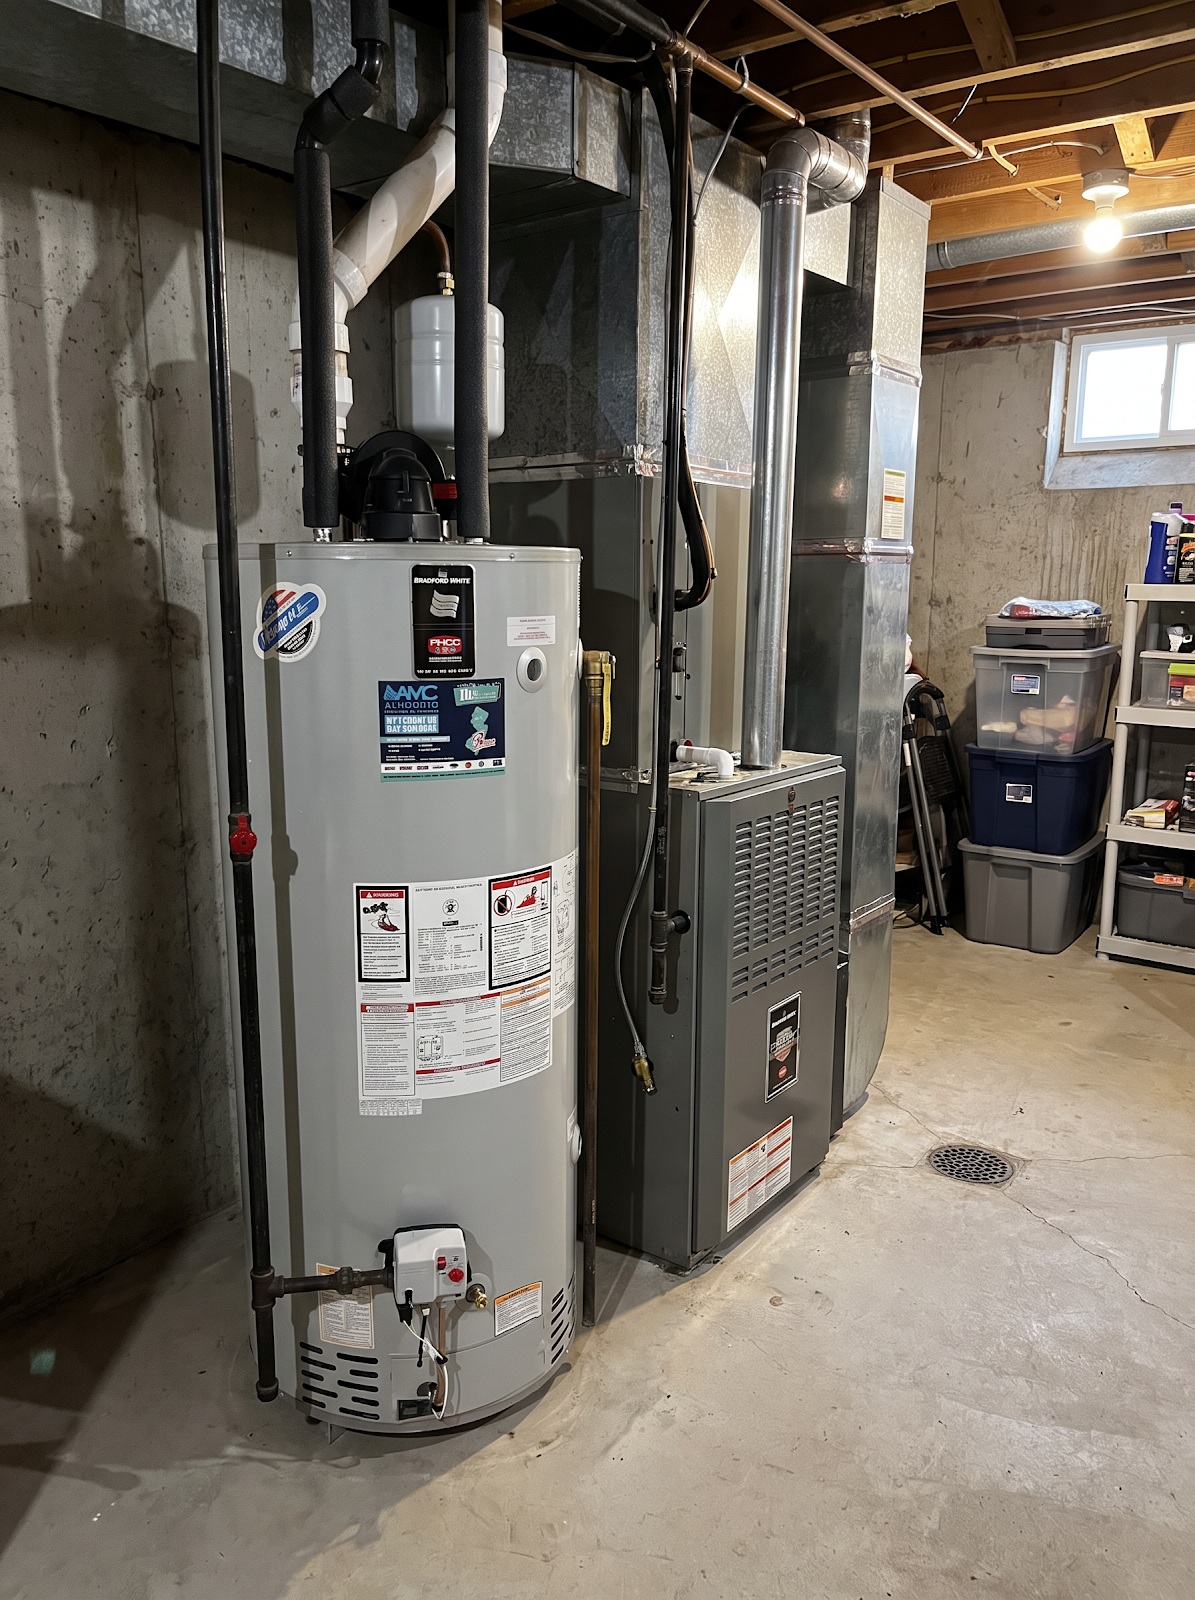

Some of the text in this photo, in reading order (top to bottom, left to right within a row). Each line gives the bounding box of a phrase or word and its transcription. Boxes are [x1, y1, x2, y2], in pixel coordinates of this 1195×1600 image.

[413, 577, 449, 585] BRADFORD
[430, 639, 461, 647] PHCC
[396, 684, 439, 701] AMC
